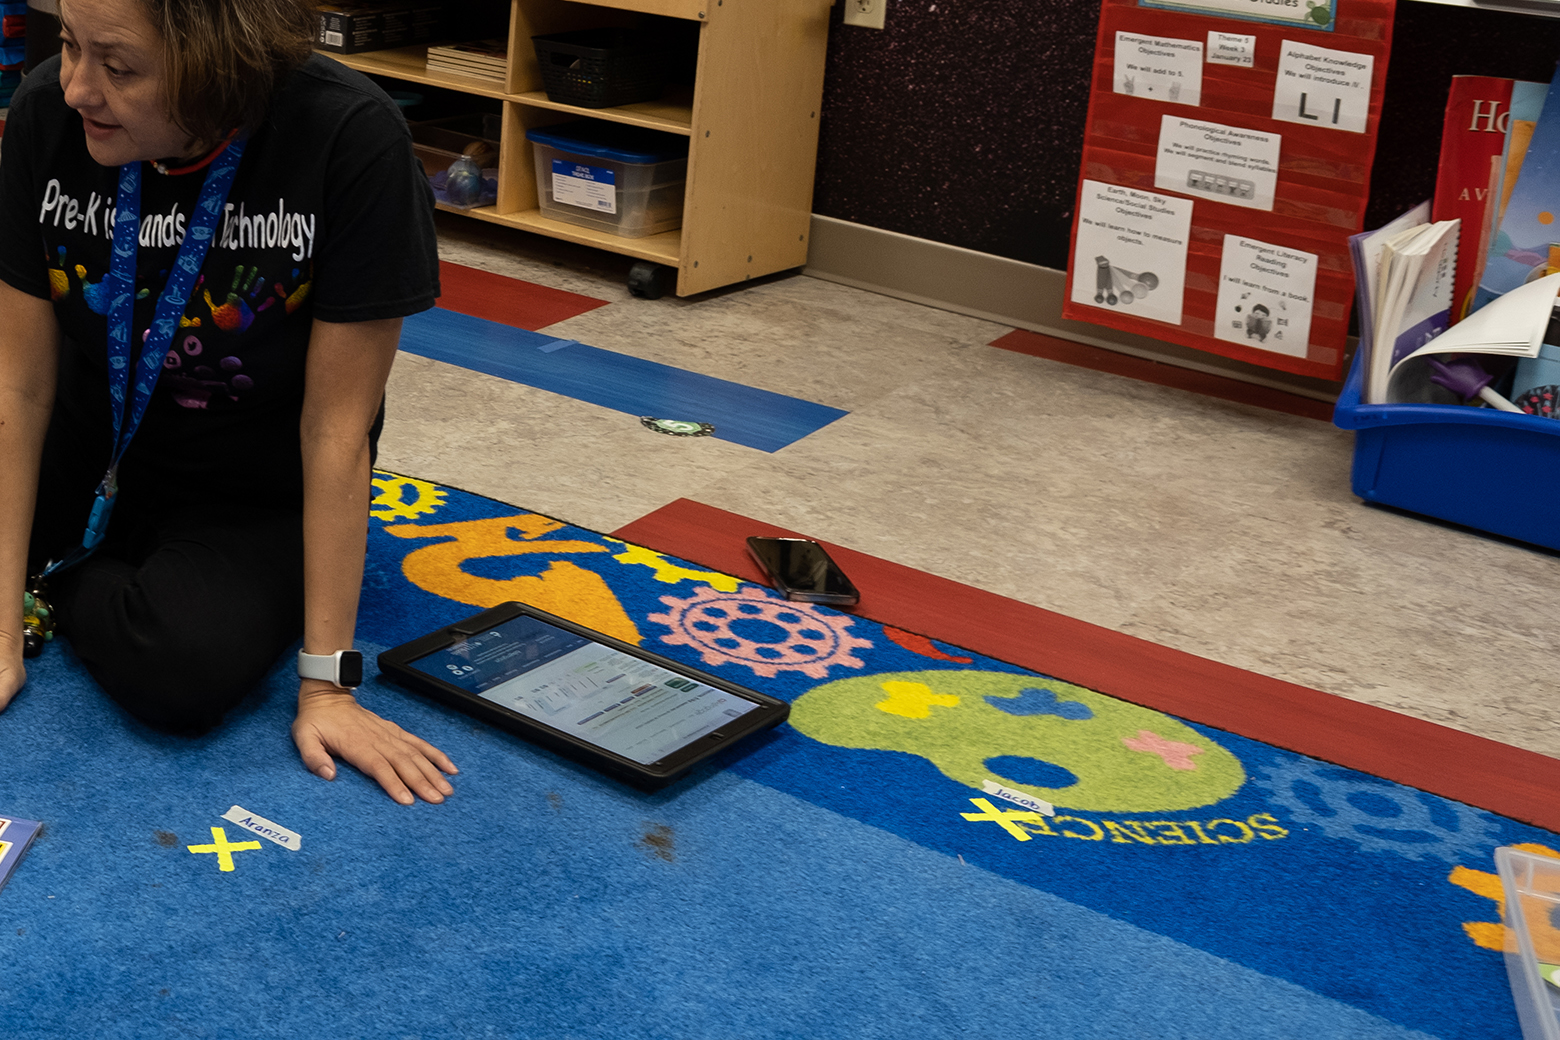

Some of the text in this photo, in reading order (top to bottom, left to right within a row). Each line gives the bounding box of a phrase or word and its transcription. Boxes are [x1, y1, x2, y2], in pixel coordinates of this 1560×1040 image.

[1118, 34, 1201, 53] Emergent Mathematics
[1217, 34, 1242, 43] Theme
[1137, 46, 1176, 58] Objectives
[1211, 52, 1241, 63] January
[1218, 44, 1238, 53] Week
[1287, 51, 1367, 71] Alphabet Knowledge
[1304, 63, 1346, 76] Objectives
[1140, 65, 1151, 73] will
[1153, 67, 1167, 76] add
[1168, 69, 1176, 77] to
[1284, 69, 1297, 77] We
[1298, 72, 1312, 80] will
[1313, 75, 1350, 87] introduce
[1298, 92, 1319, 121] L
[1179, 120, 1269, 143] Phonological Awareness
[1203, 133, 1242, 147] Objectives
[1187, 151, 1214, 162] segment
[1215, 157, 1227, 165] and
[1228, 159, 1247, 168] blend
[1195, 146, 1220, 157] practice
[1221, 152, 1248, 163] rhyming
[1107, 186, 1128, 197] Earth,
[1153, 195, 1167, 206] Sky
[1458, 187, 1471, 201] A
[40, 179, 101, 236] Pre-K
[1096, 193, 1176, 216] Science/Social Studies
[1115, 207, 1153, 220] Objectives
[138, 202, 186, 248] ands
[1082, 217, 1093, 225] We
[1094, 220, 1107, 228] will
[1108, 223, 1126, 232] learn
[1127, 227, 1142, 236] how
[1152, 233, 1182, 245] measure
[1239, 240, 1308, 264] Emergent Literacy
[1256, 254, 1287, 268] Reading
[1249, 262, 1290, 278] Objectives
[1228, 276, 1241, 284] will
[1241, 279, 1261, 290] learn
[1262, 283, 1280, 295] from
[993, 788, 1040, 810] Jacob
[239, 816, 290, 844] Aranza
